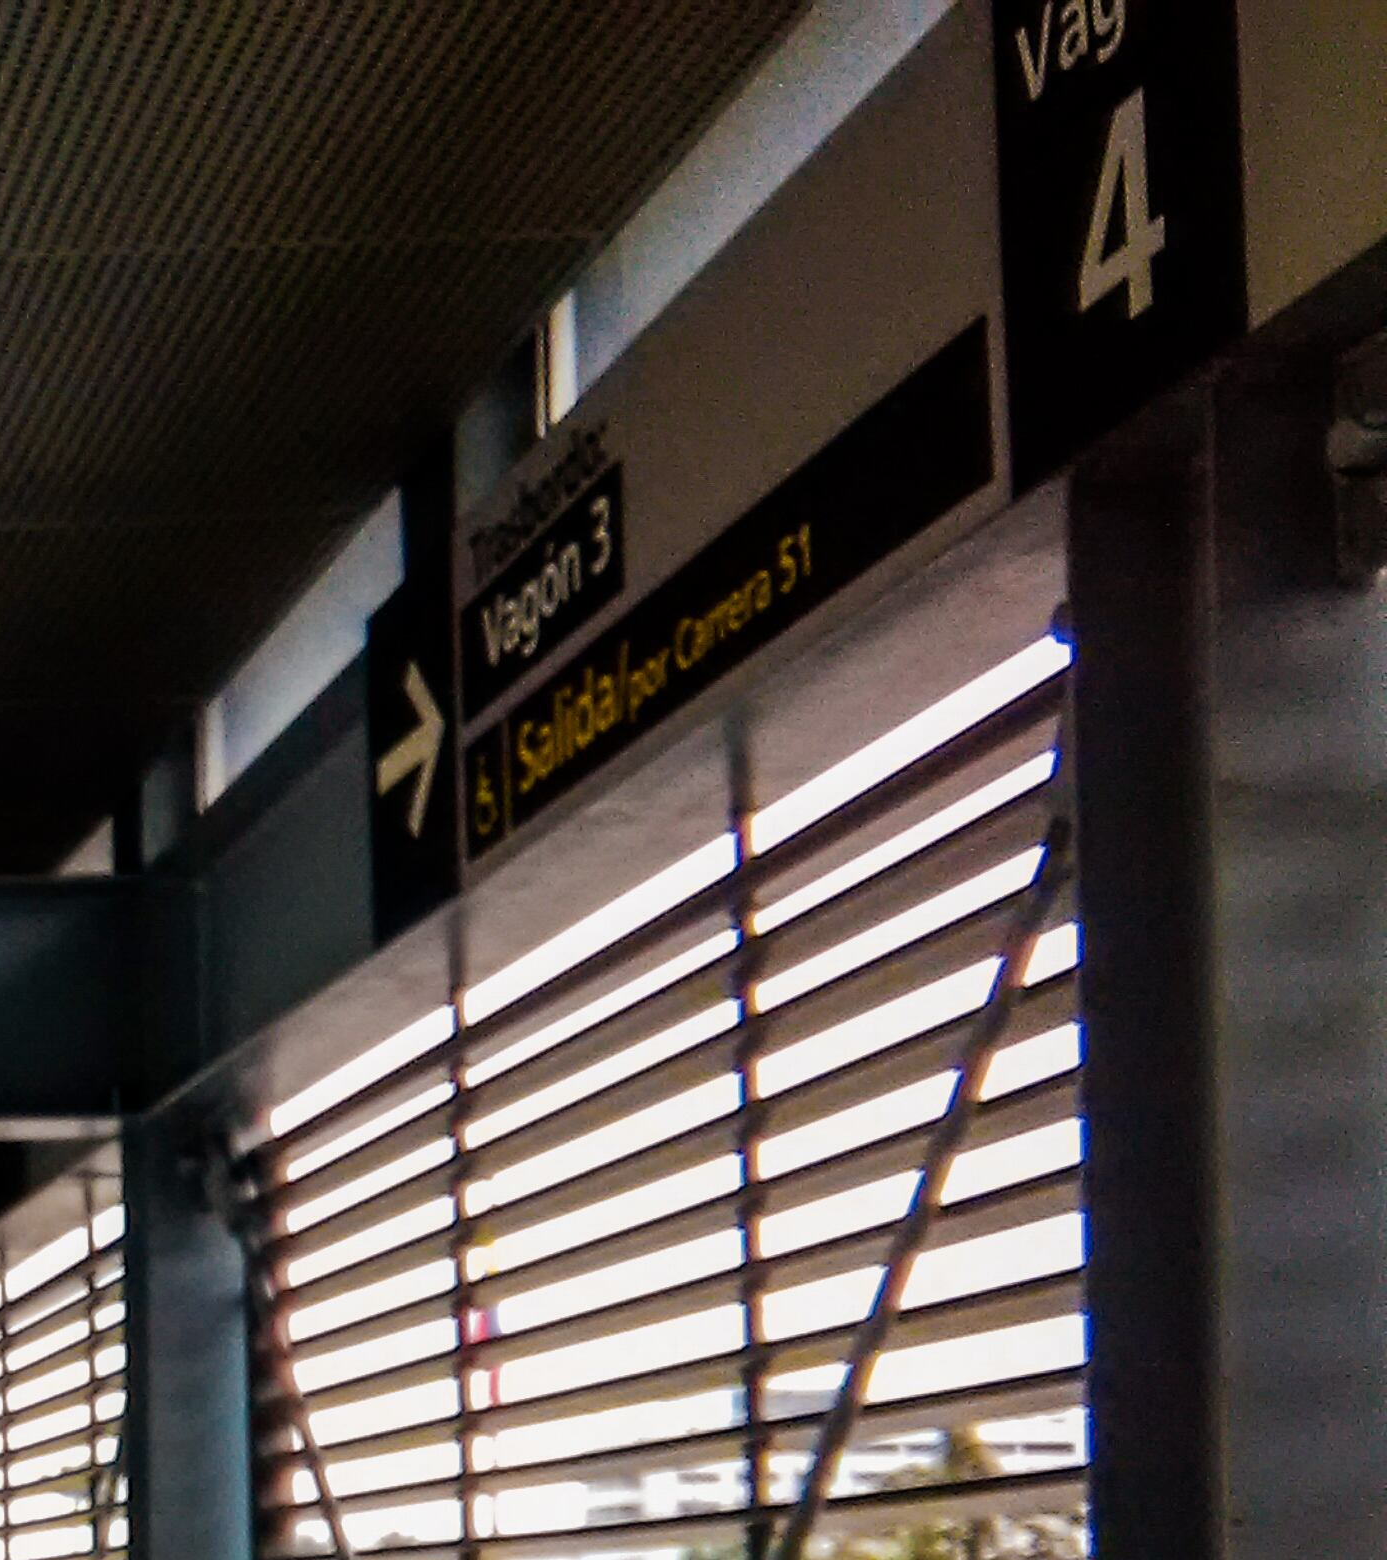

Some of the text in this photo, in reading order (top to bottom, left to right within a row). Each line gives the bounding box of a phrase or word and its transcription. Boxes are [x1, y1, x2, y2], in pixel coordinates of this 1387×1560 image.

[1079, 84, 1166, 321] 4
[481, 496, 612, 668] Vagón 3
[673, 568, 773, 671] Carrera
[777, 521, 812, 595] 51
